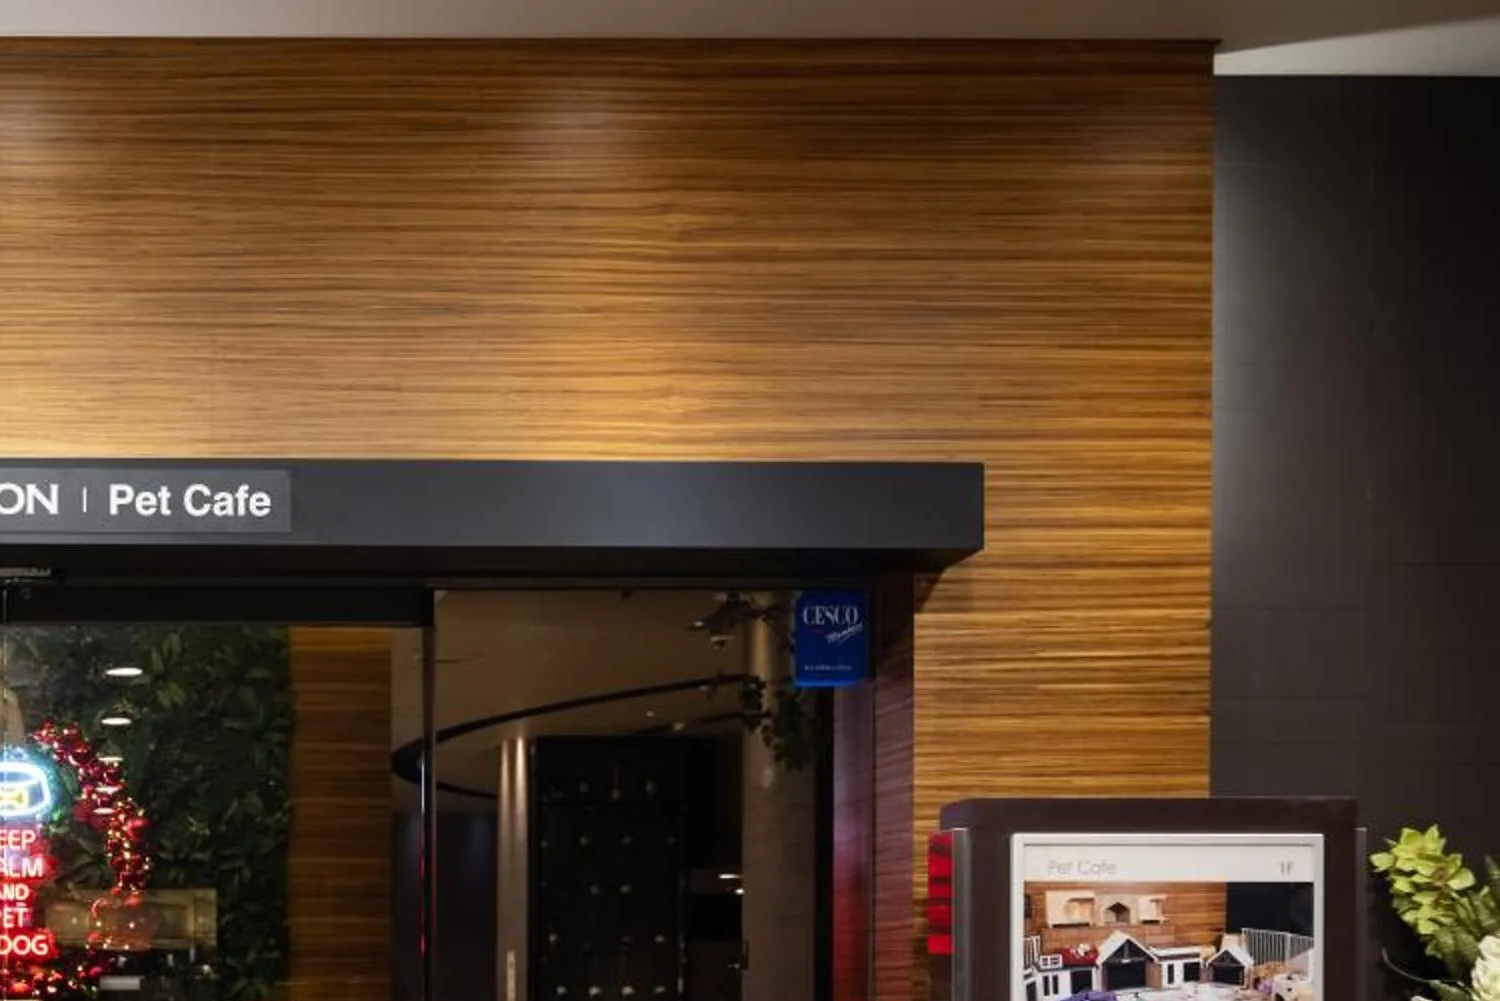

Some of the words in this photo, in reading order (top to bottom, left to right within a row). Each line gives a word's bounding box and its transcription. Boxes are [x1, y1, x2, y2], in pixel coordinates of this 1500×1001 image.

[109, 483, 172, 517] Pet
[183, 483, 271, 518] Cafe
[802, 605, 860, 625] CESCO
[1047, 859, 1073, 876] Pet
